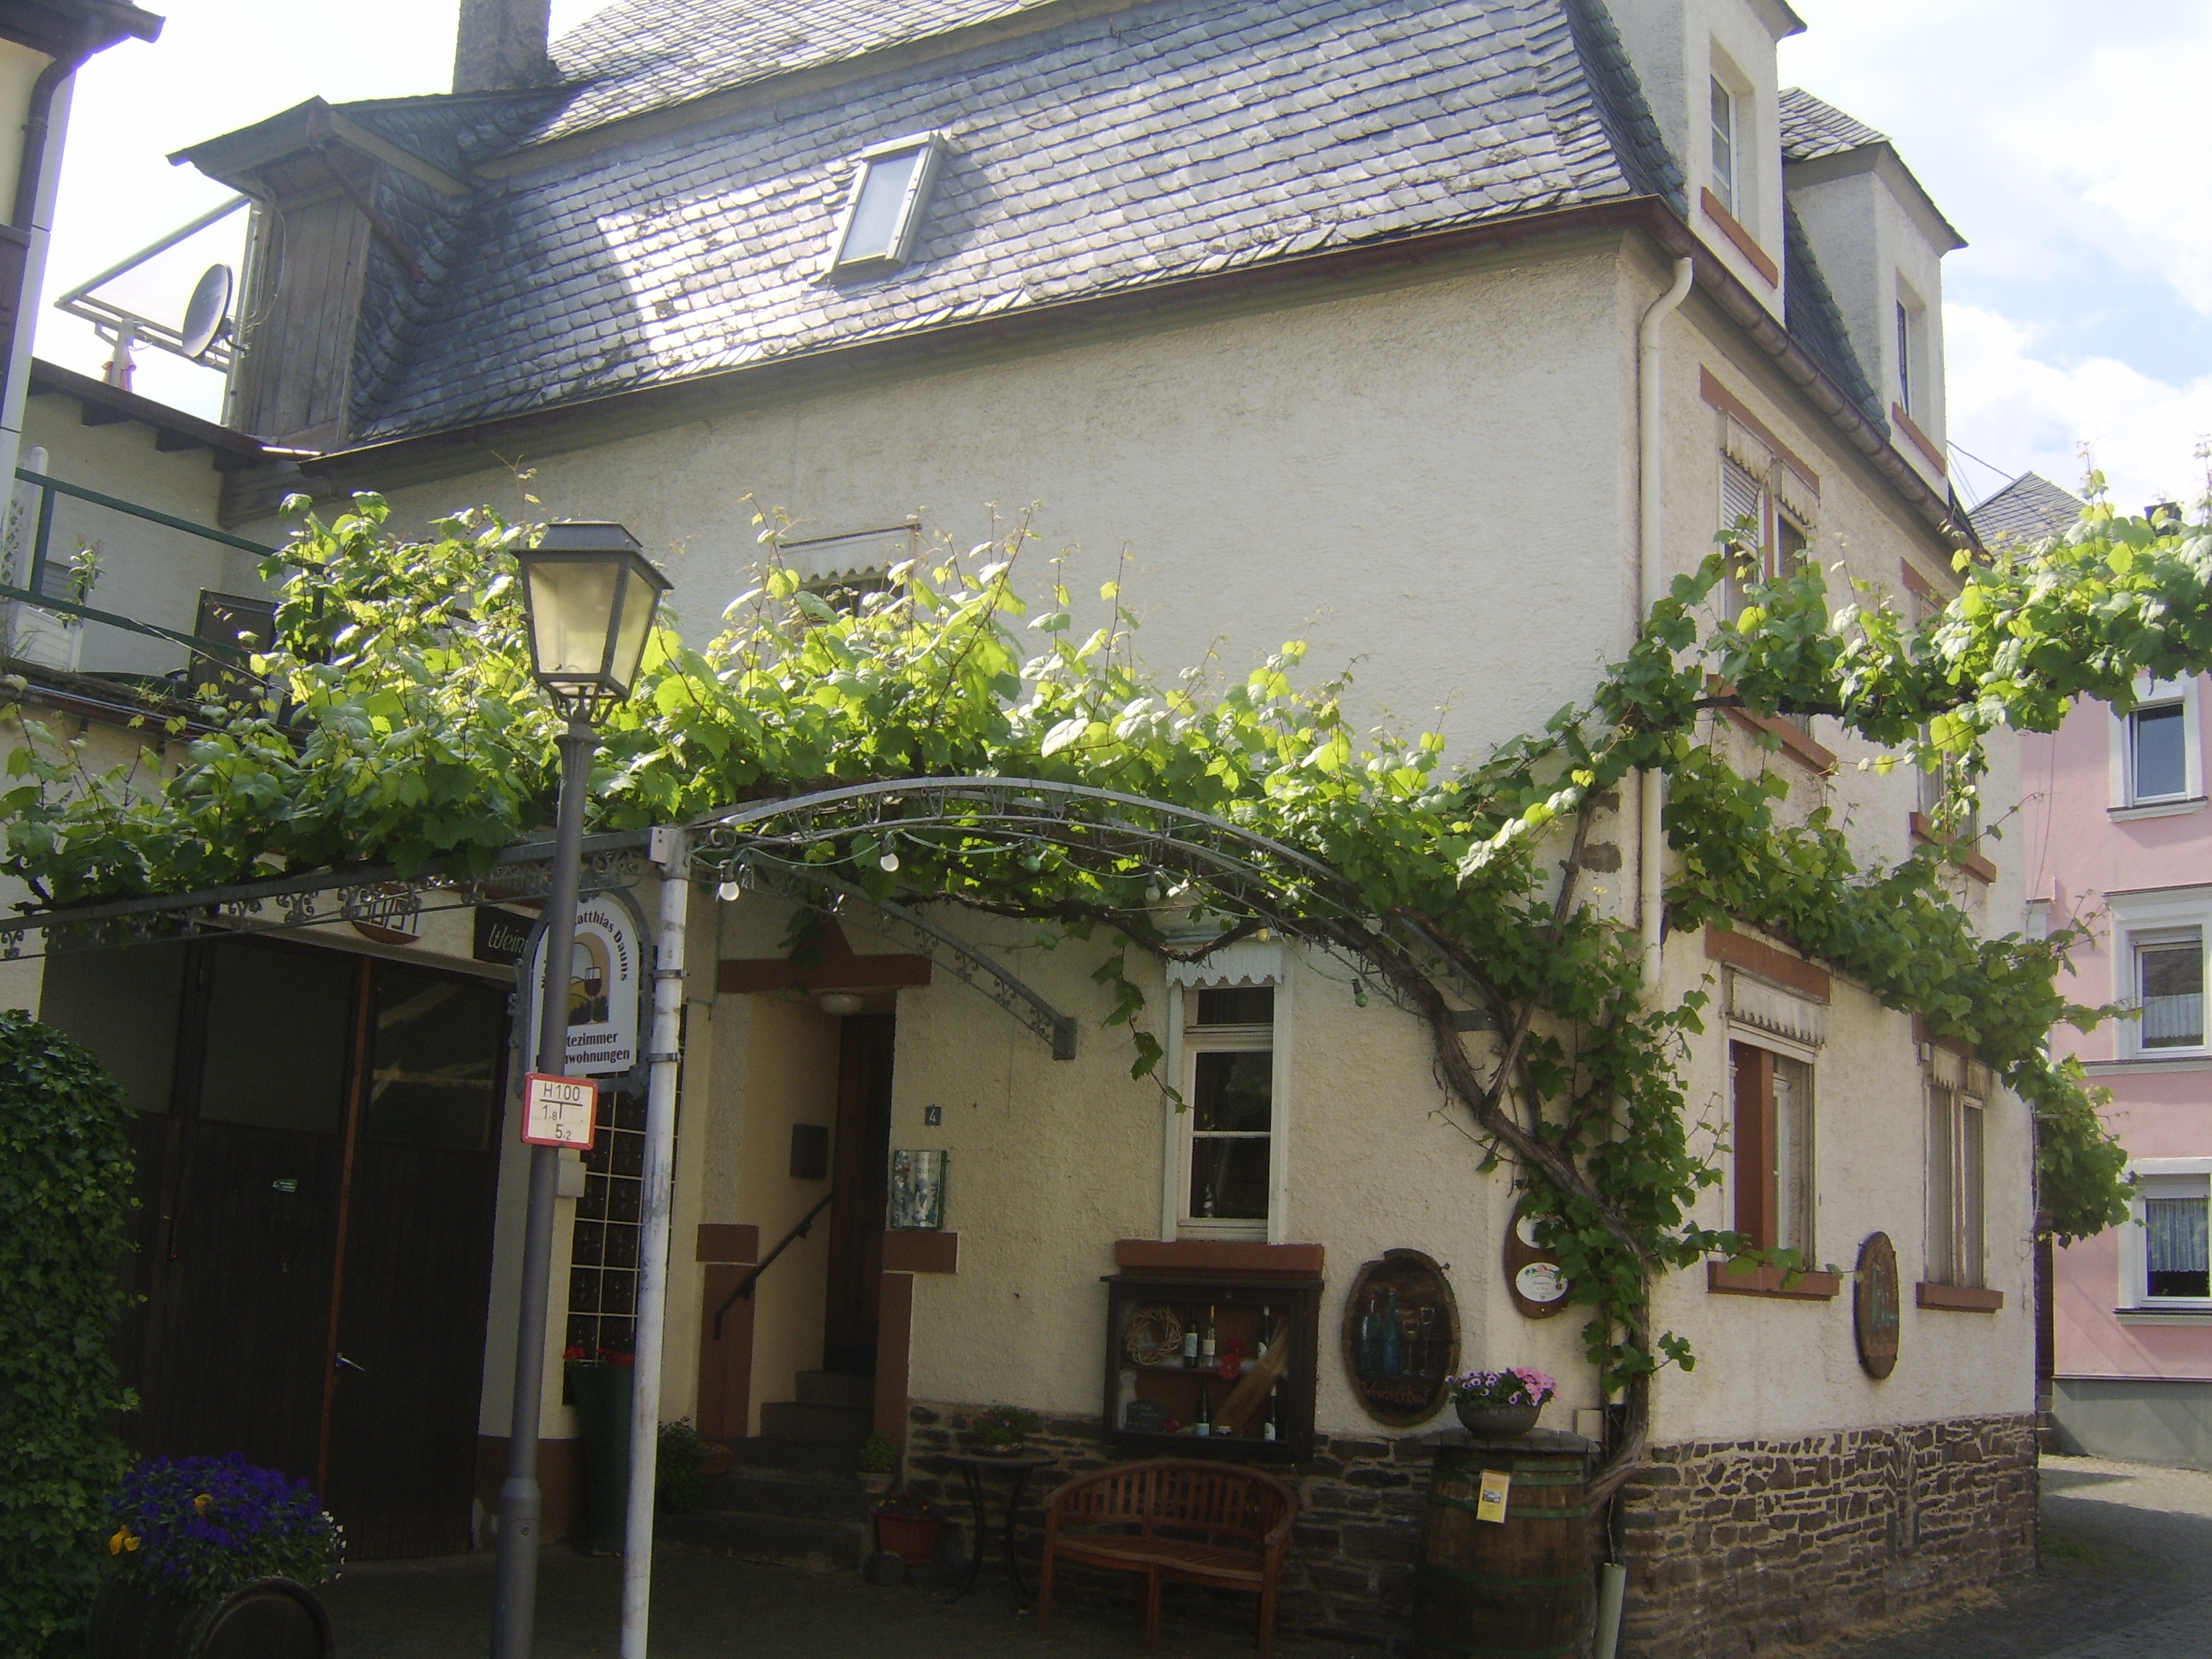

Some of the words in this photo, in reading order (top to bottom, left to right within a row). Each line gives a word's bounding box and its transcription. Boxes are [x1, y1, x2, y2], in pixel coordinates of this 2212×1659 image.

[488, 924, 529, 953] Wein
[576, 911, 614, 933] atthias
[613, 930, 629, 981] Dauns
[567, 1033, 619, 1048] tezimmer
[929, 1109, 936, 1123] 4
